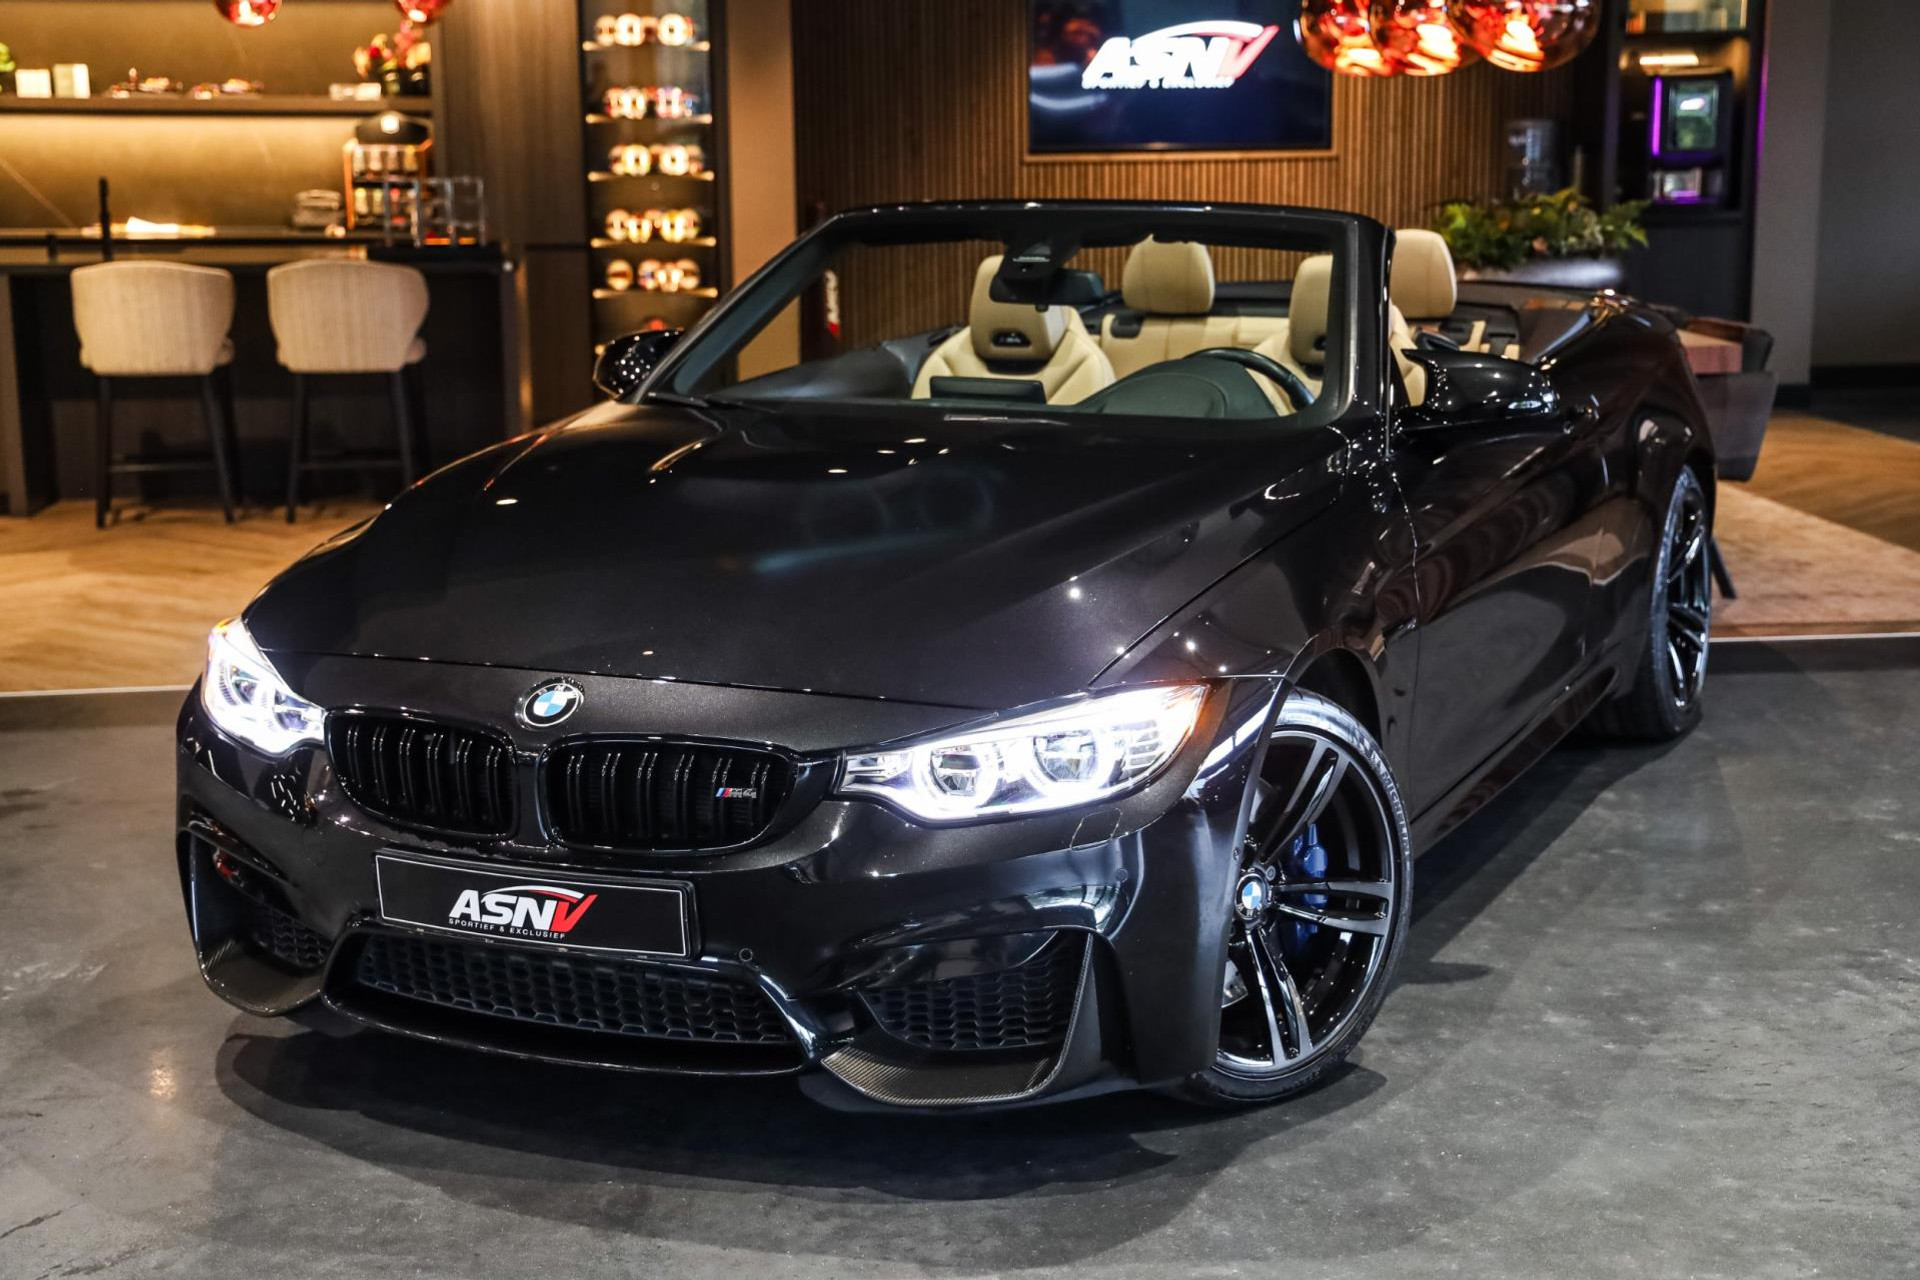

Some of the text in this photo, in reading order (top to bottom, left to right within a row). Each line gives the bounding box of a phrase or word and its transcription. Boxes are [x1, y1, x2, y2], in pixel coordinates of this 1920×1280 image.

[1082, 23, 1279, 82] ASNV
[448, 918, 495, 931] SPORTIEF
[510, 926, 566, 939] EXCLUSIEF
[449, 887, 598, 932] ASNV
